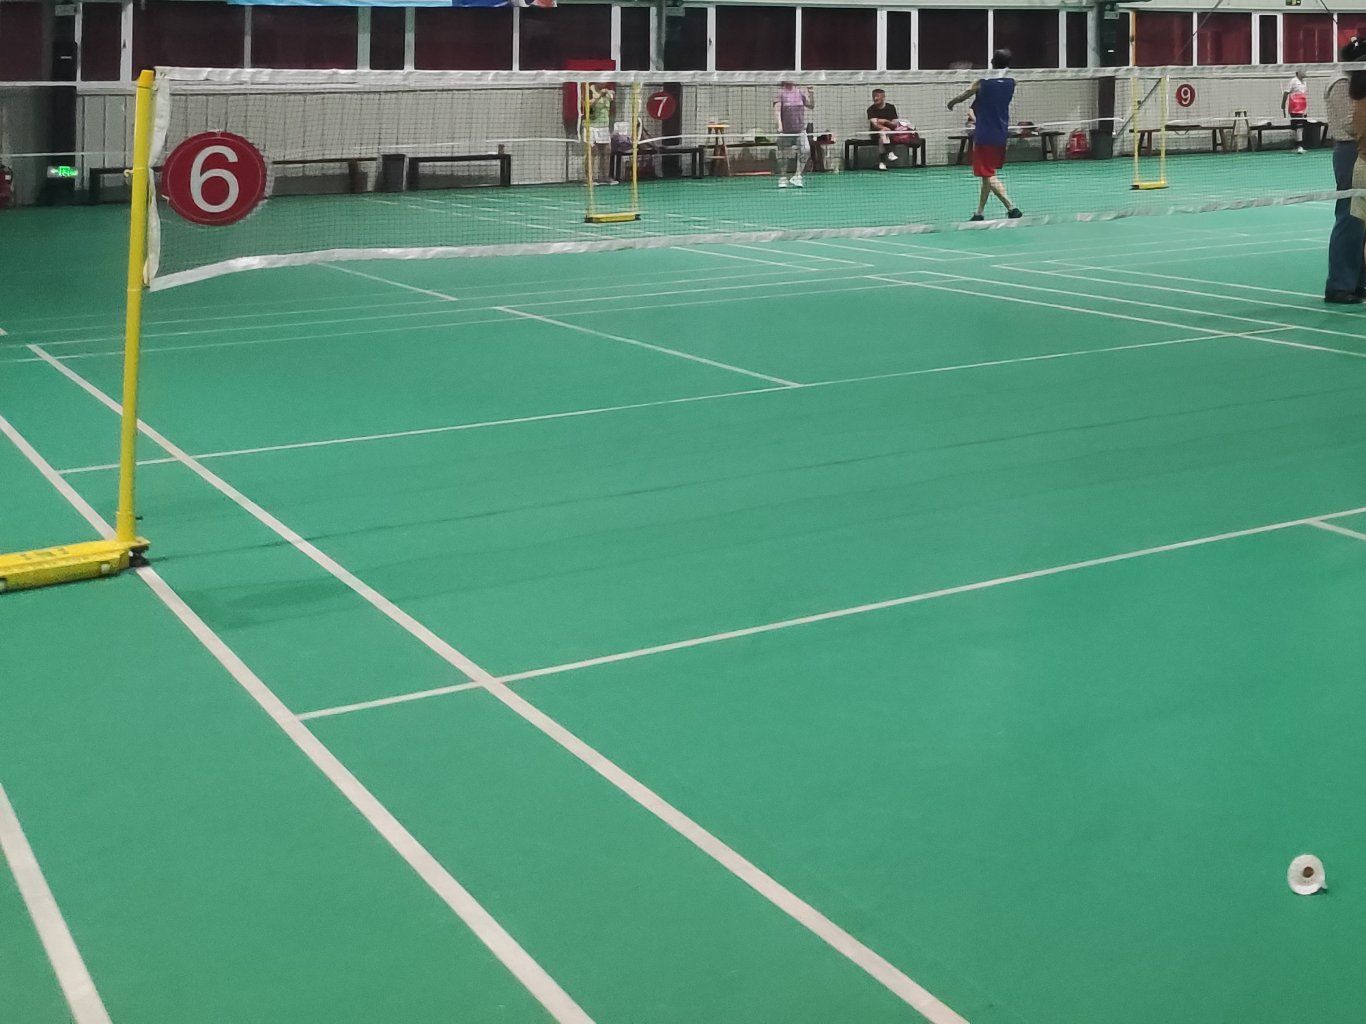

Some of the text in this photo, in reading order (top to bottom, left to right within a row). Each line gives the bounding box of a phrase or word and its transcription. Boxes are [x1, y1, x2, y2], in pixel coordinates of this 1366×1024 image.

[653, 96, 669, 117] 7
[1180, 87, 1191, 105] 9
[190, 145, 239, 214] 6
